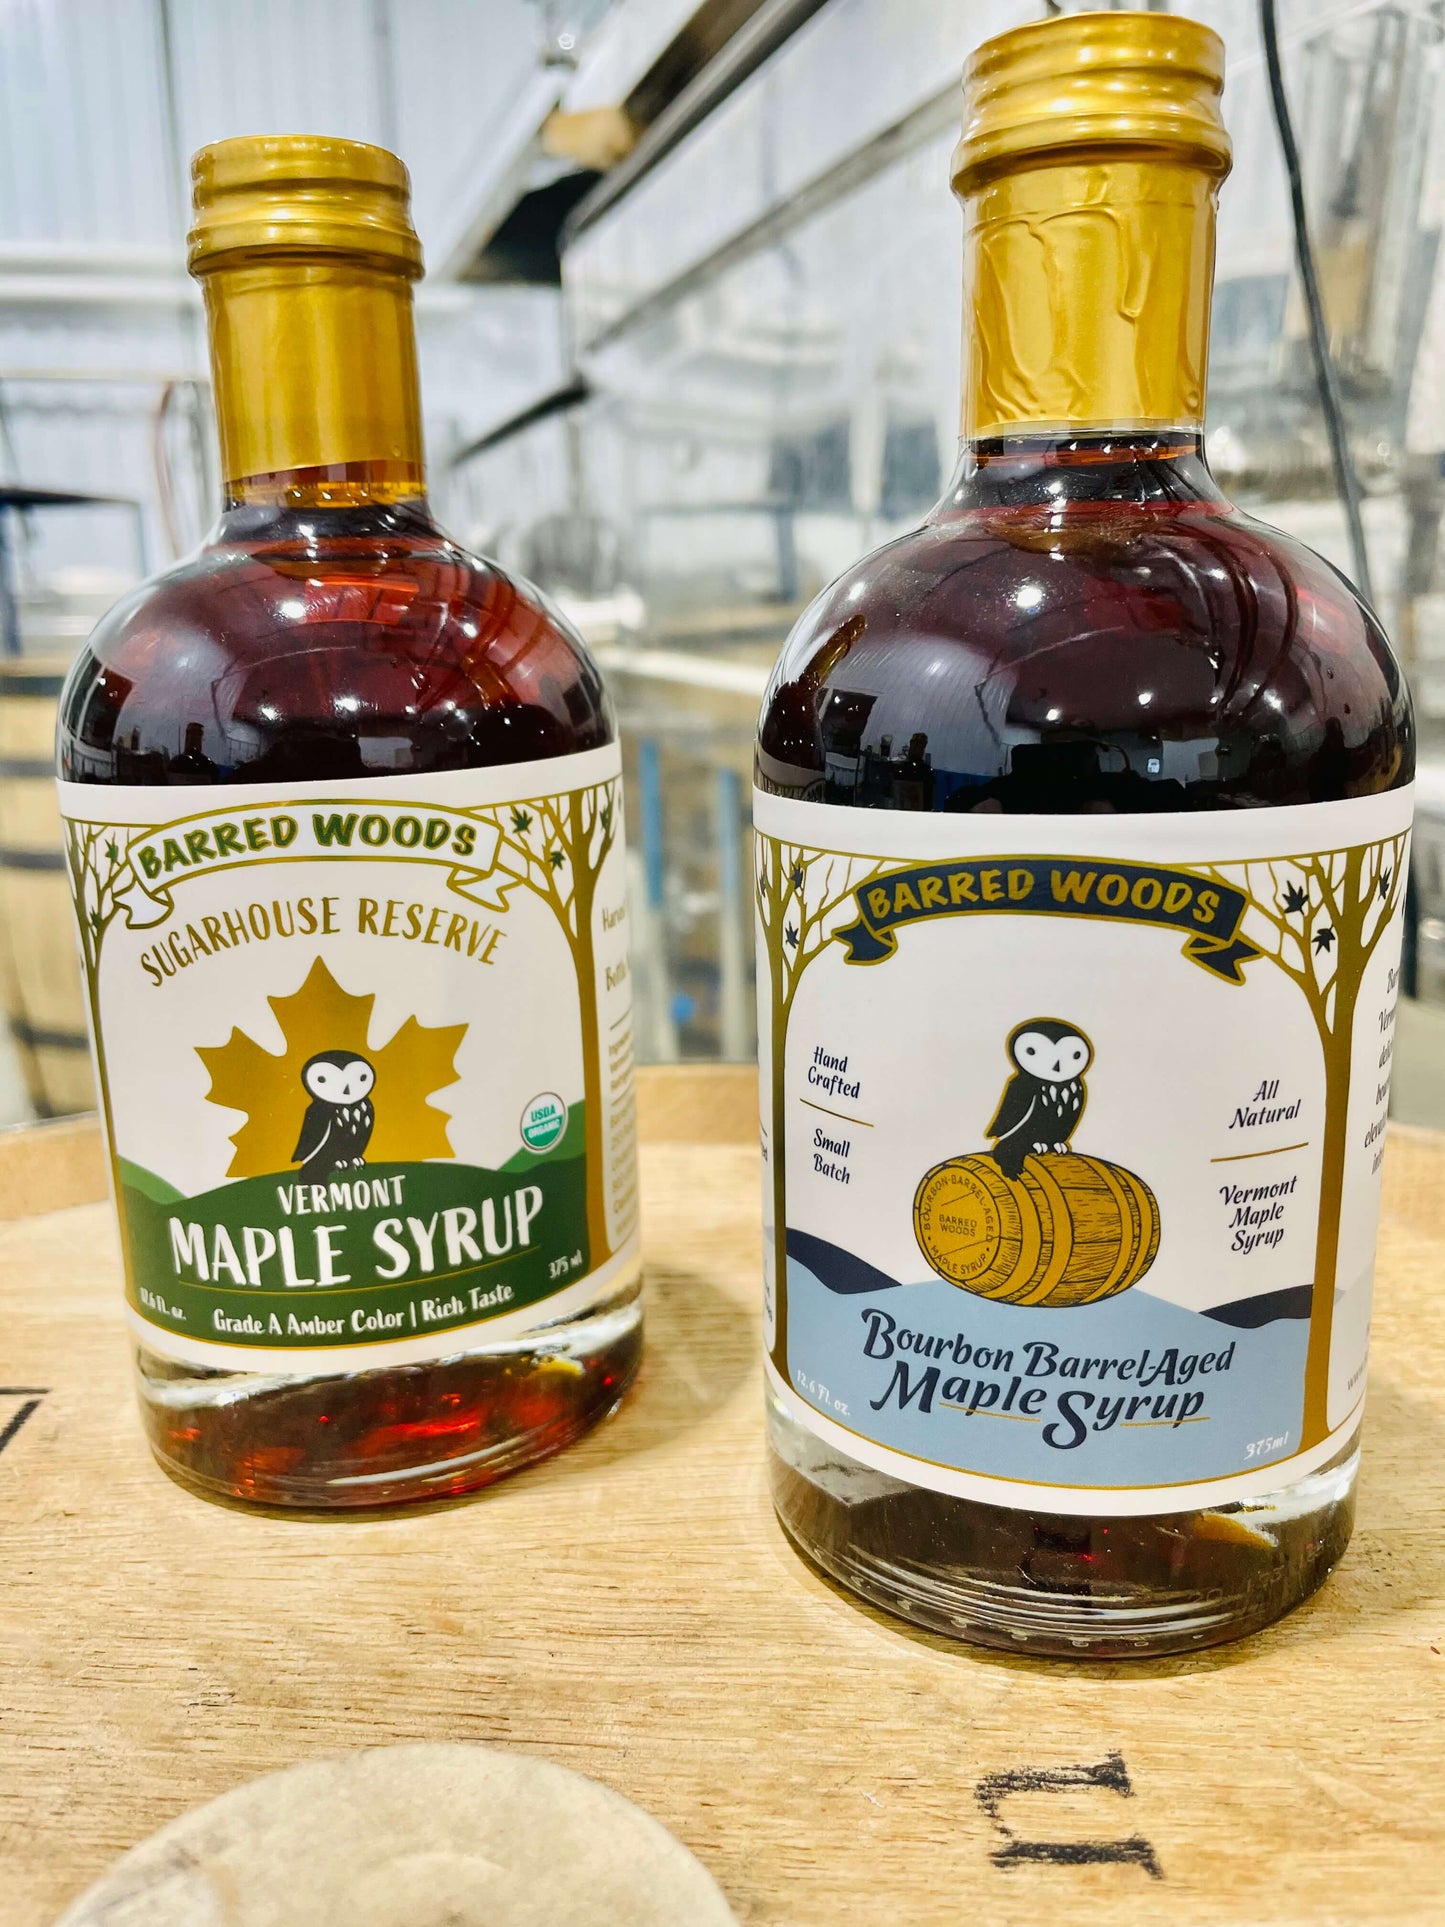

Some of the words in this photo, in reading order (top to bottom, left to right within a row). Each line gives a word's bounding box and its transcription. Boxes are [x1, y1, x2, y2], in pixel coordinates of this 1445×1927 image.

[137, 814, 298, 879] BARRED
[312, 813, 476, 857] WOODS
[867, 868, 1034, 920] BARRED
[1050, 869, 1220, 923] WOODS
[140, 897, 341, 987] SUGARHOUSE
[358, 897, 507, 965] RESERVE
[813, 1046, 848, 1073] Hand
[808, 1066, 860, 1099] Crafted
[1253, 1080, 1279, 1102] All
[531, 1104, 556, 1122] USDA
[1229, 1099, 1301, 1129] Natural
[813, 1128, 850, 1157] Small
[813, 1154, 850, 1184] Batch
[277, 1175, 406, 1215] VERMONT
[1219, 1176, 1297, 1206] Vermont
[939, 1214, 977, 1228] BARRED
[941, 1223, 975, 1237] WOODS
[1228, 1202, 1284, 1229] Maple
[169, 1217, 351, 1287] MAPLE
[373, 1185, 543, 1278] SYRUP
[1231, 1228, 1284, 1255] Syrup
[548, 1255, 569, 1280] 375
[931, 1245, 957, 1273] MAPLE
[960, 1253, 986, 1275] SYRUP
[171, 1306, 187, 1321] oz.
[213, 1308, 265, 1334] Grade
[268, 1313, 283, 1335] A
[287, 1313, 345, 1335] Amber
[351, 1309, 405, 1332] Color
[421, 1296, 467, 1322] Rich
[468, 1283, 515, 1310] Taste
[861, 1308, 1014, 1372] Bourbon
[1022, 1341, 1236, 1387] Barrel-Aged
[797, 1370, 816, 1394] 12.6
[817, 1384, 831, 1405] Fl.
[834, 1400, 850, 1416] oz.
[869, 1360, 1047, 1416] Maple
[1042, 1391, 1204, 1450] Syrup
[1243, 1431, 1288, 1461] 375ml
